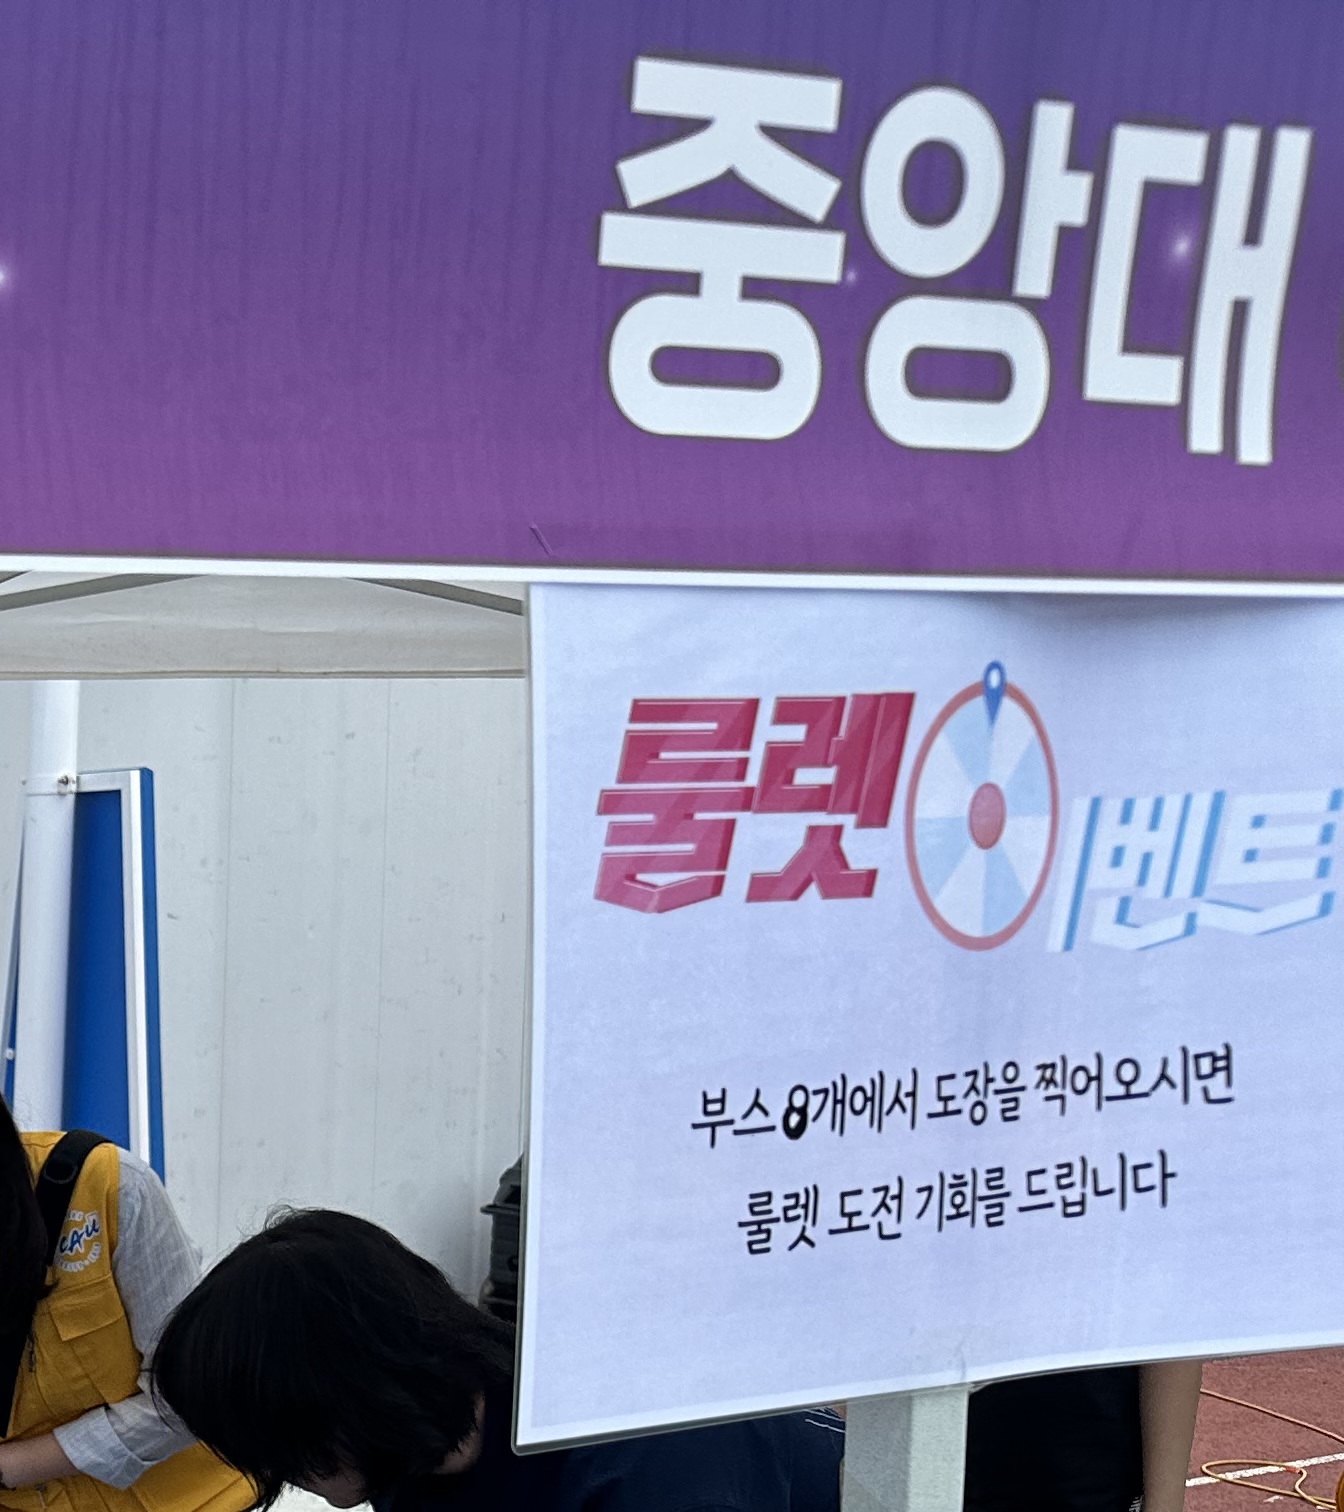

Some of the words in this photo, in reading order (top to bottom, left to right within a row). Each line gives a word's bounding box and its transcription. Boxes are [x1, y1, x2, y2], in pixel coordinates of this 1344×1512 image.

[598, 56, 1312, 466] 중앙대
[594, 691, 916, 914] 룰렛
[691, 1087, 776, 1149] 부스
[782, 1067, 918, 1141] 8개에서
[927, 1061, 1027, 1126] 도장을
[738, 1184, 819, 1255] 룰렛
[828, 1175, 903, 1240] 도전
[916, 1167, 1011, 1232] 기회를
[1018, 1149, 1177, 1219] 드립니다
